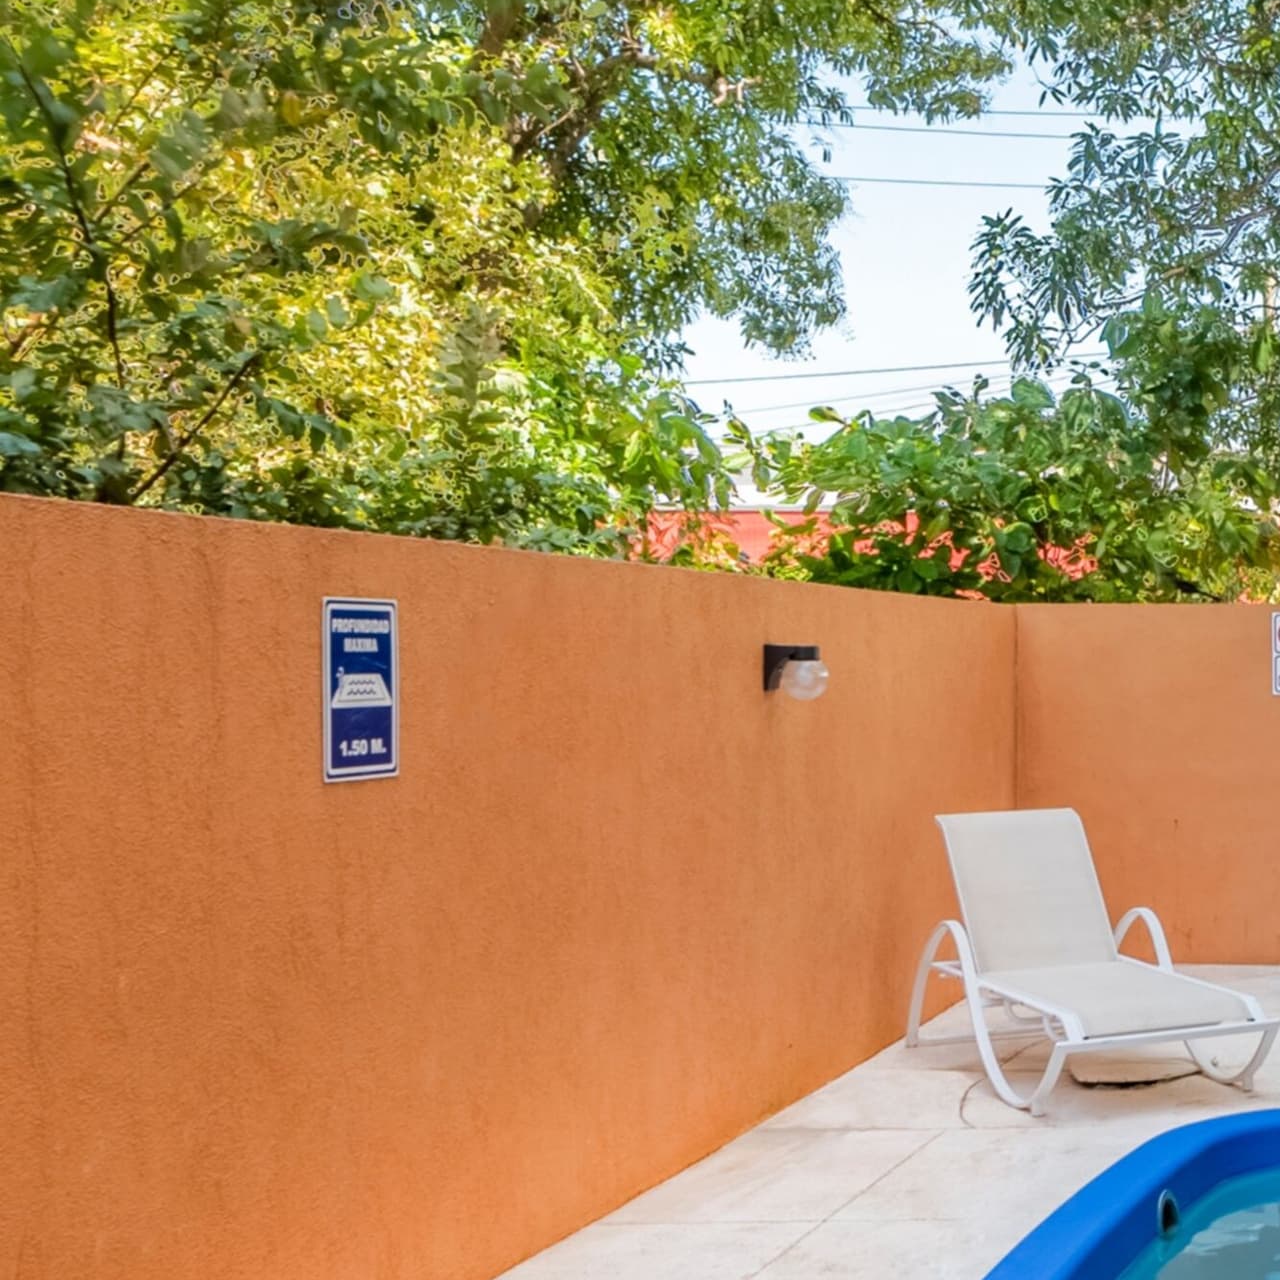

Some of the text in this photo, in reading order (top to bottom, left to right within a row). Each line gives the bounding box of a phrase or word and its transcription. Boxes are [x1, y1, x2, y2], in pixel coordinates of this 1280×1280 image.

[331, 618, 390, 634] PROFUNDIDAD
[343, 638, 379, 653] MAXIMA
[339, 738, 387, 757] 1.50 M.
